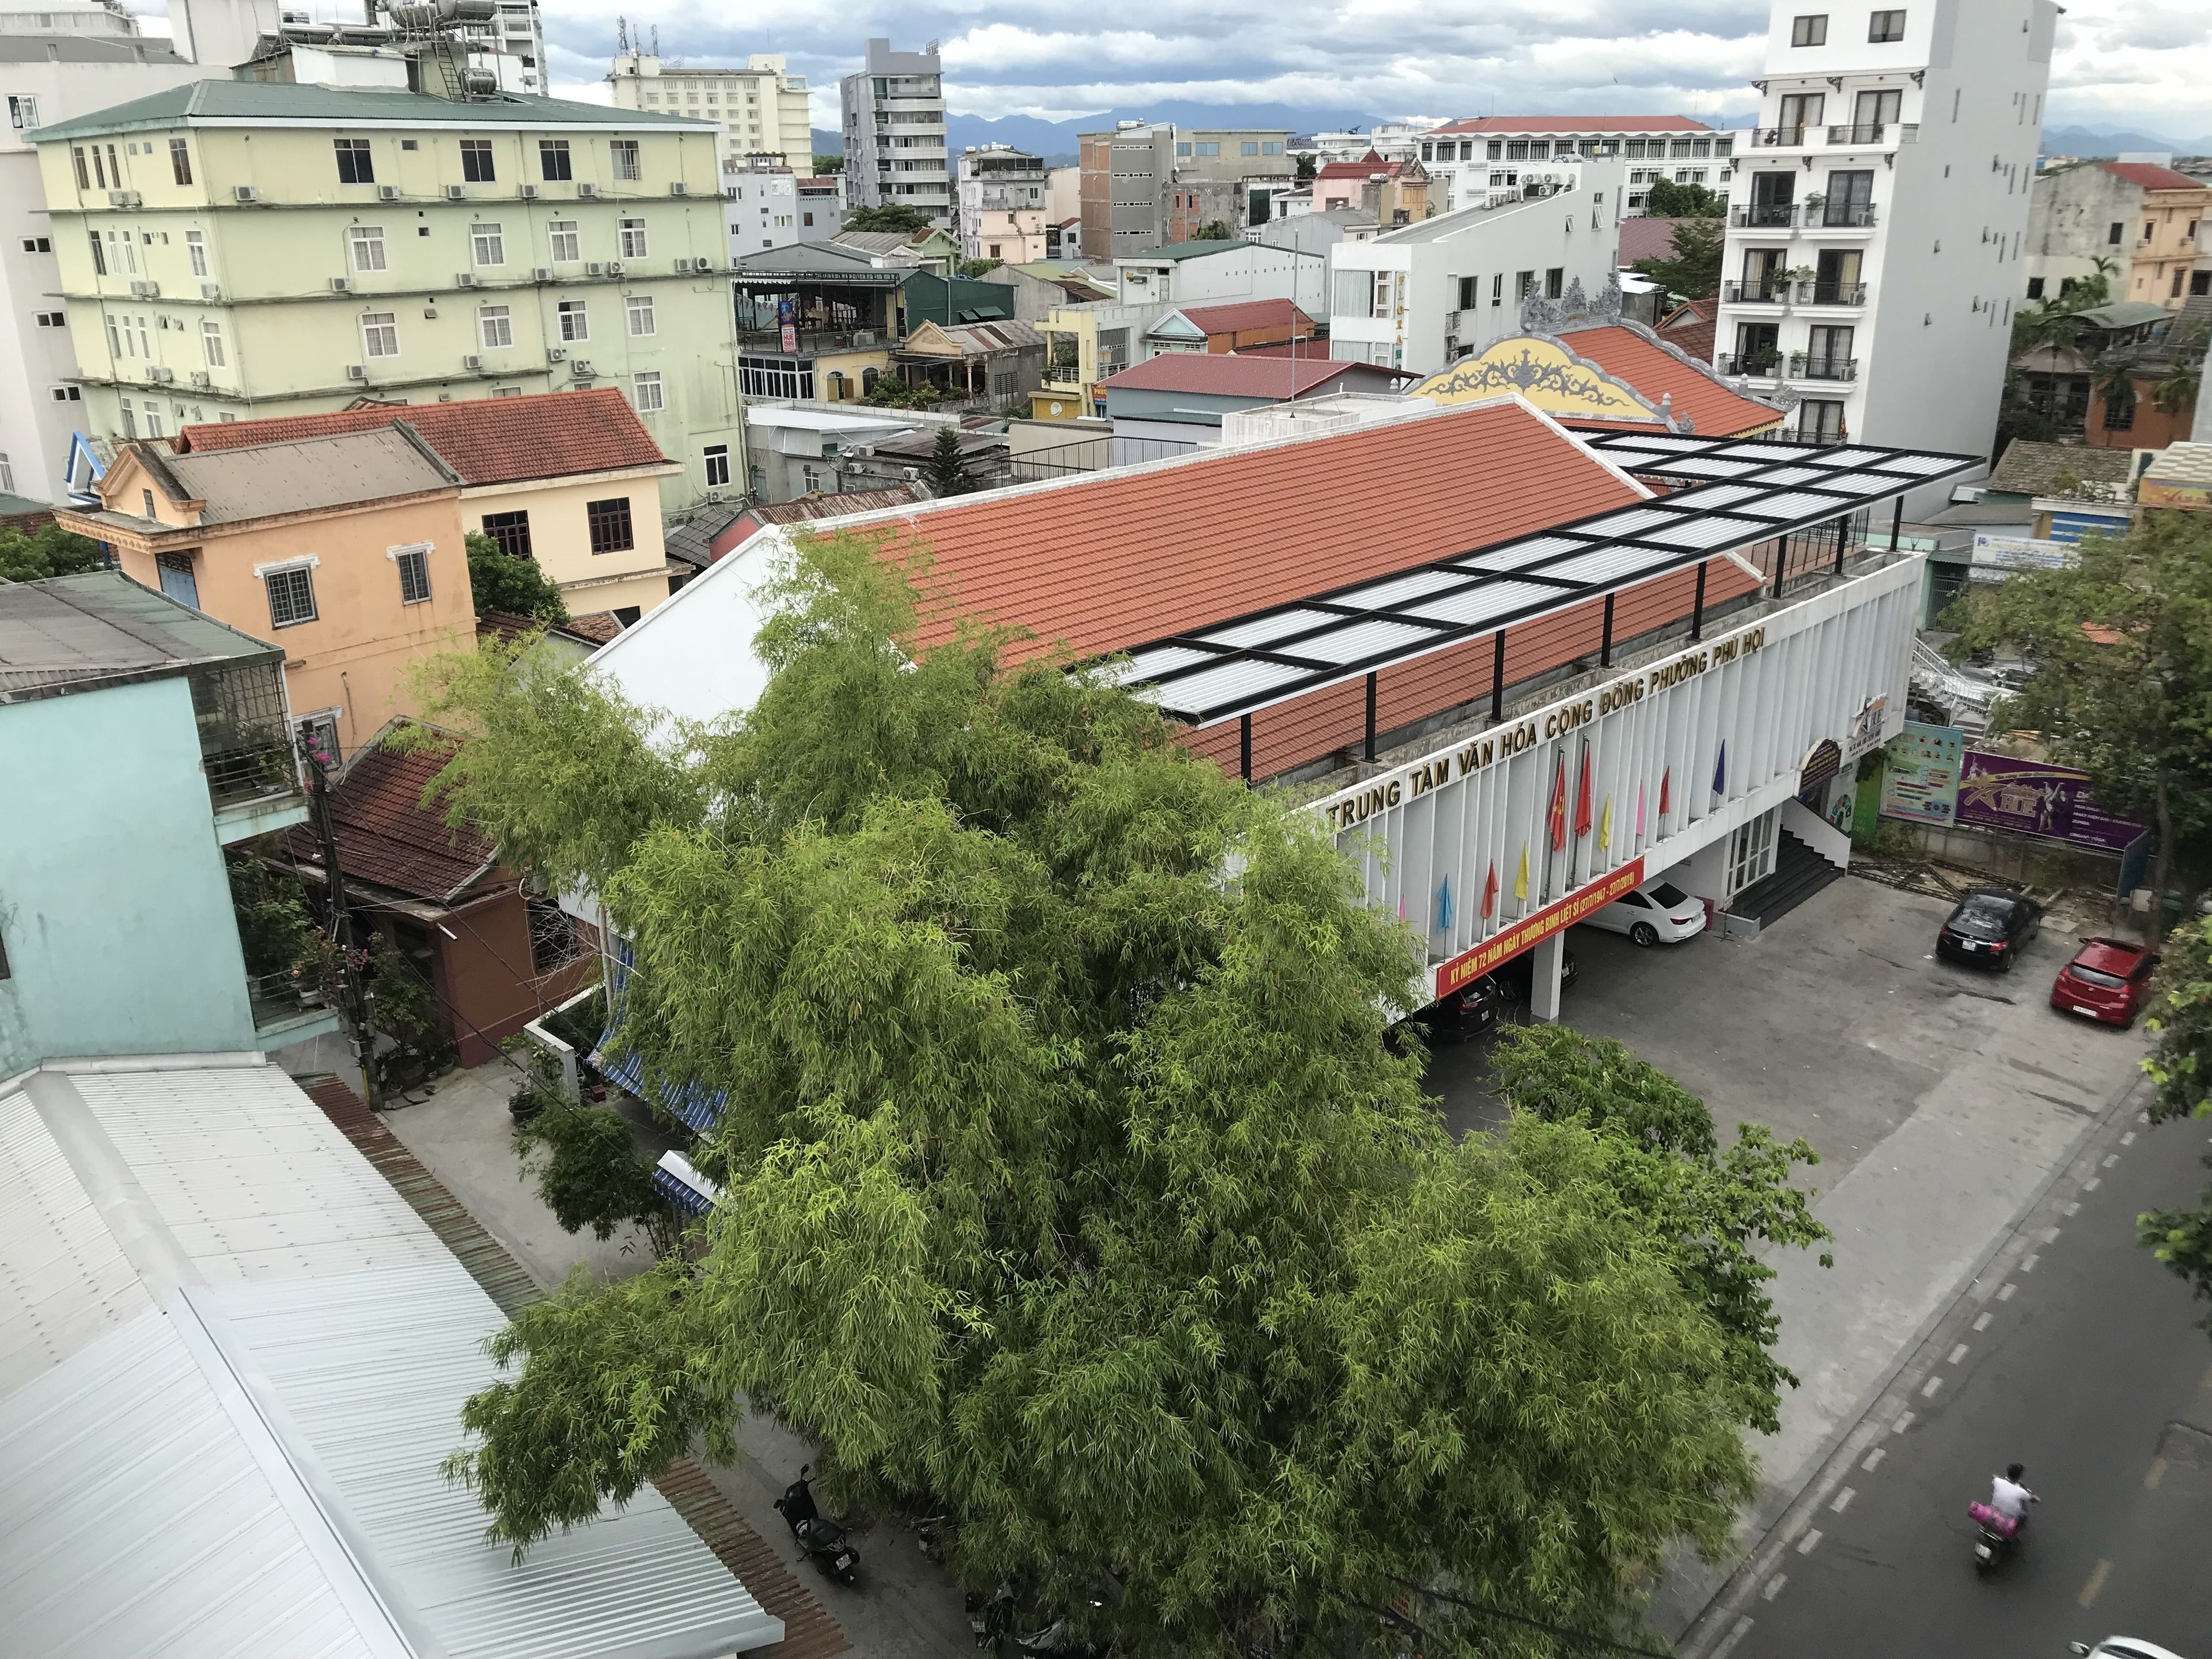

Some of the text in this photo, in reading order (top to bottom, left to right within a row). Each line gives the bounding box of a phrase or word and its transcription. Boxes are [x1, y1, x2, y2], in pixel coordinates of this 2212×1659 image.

[1326, 780, 1400, 831] TRUNG
[1410, 758, 1449, 797] TÂM
[1457, 740, 1493, 776] VĂN
[1499, 721, 1537, 759] HÓA
[1545, 699, 1593, 738] CỘNG
[1599, 678, 1643, 716] ĐỒNG
[1649, 652, 1707, 695] PHƯỜNG
[1711, 634, 1738, 668] PHÚ
[1460, 957, 1477, 979] NIỆM
[1479, 952, 1486, 969] 72
[1488, 943, 1502, 964] NĂM
[1503, 933, 1520, 955] NGÀY
[1521, 919, 1544, 945] THƯƠNG
[1546, 911, 1559, 932] BINH
[1560, 903, 1572, 924] LIỆT
[1573, 897, 1580, 916] SĨ
[1609, 871, 1635, 896] 27/7/2019)
